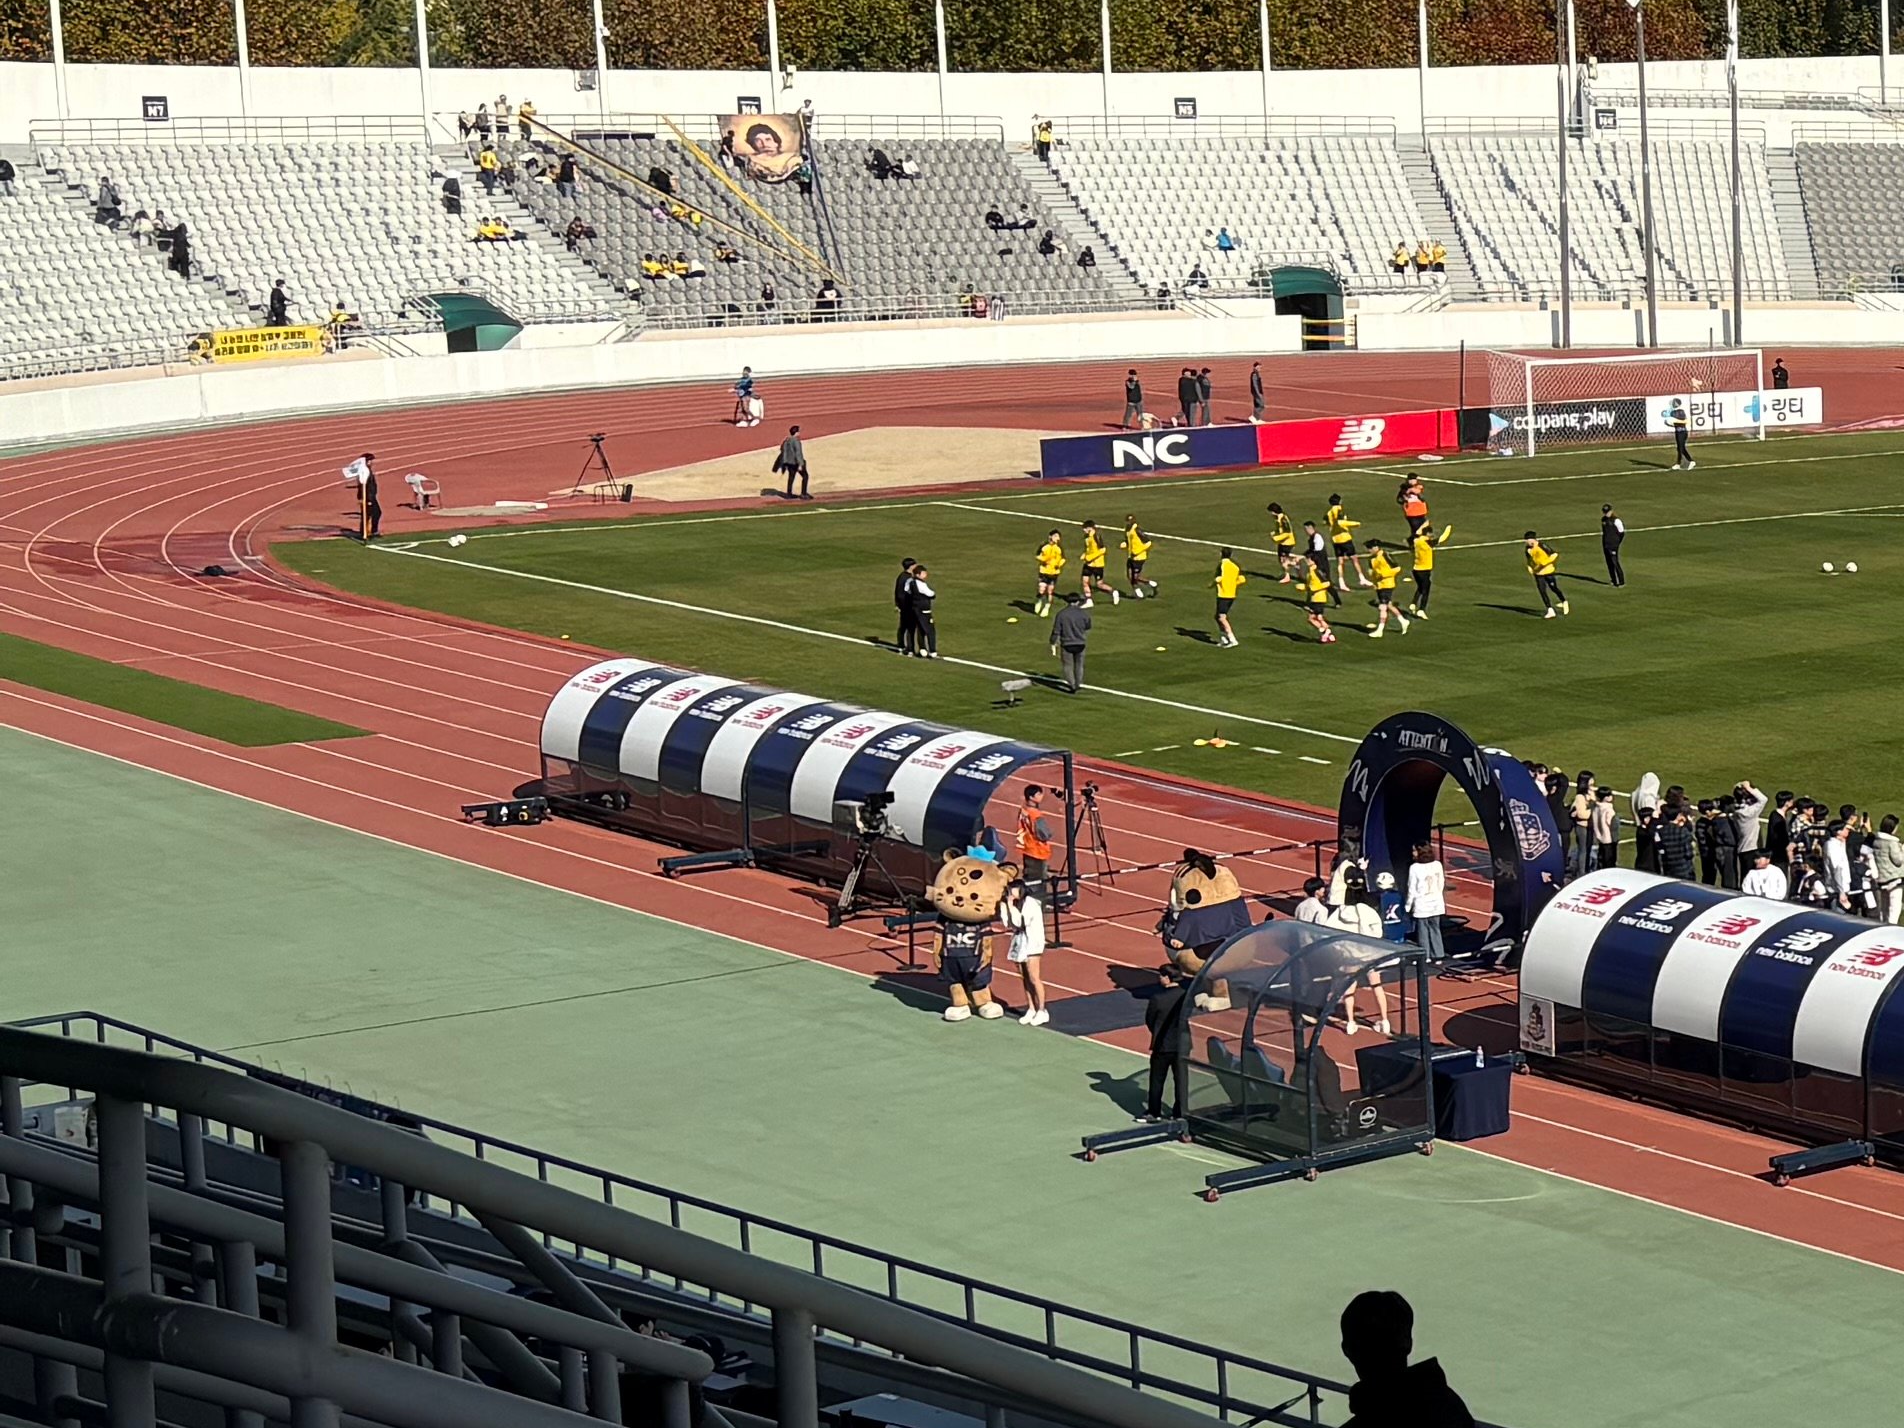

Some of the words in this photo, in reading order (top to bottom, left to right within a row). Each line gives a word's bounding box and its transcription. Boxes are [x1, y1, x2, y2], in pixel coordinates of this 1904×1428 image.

[1513, 413, 1579, 431] coupang
[1580, 407, 1616, 430] play
[1771, 398, 1804, 425] 링티
[1112, 434, 1191, 468] NC
[1553, 901, 1573, 911] new
[1573, 904, 1606, 918] balance
[1618, 915, 1639, 926] new
[1639, 917, 1674, 934] balance
[946, 932, 976, 945] NC
[1686, 930, 1706, 941] new
[1707, 933, 1741, 949] balance
[1755, 946, 1775, 957] new
[1775, 947, 1814, 965] balance
[1828, 962, 1848, 973] new
[1848, 963, 1886, 980] balance
